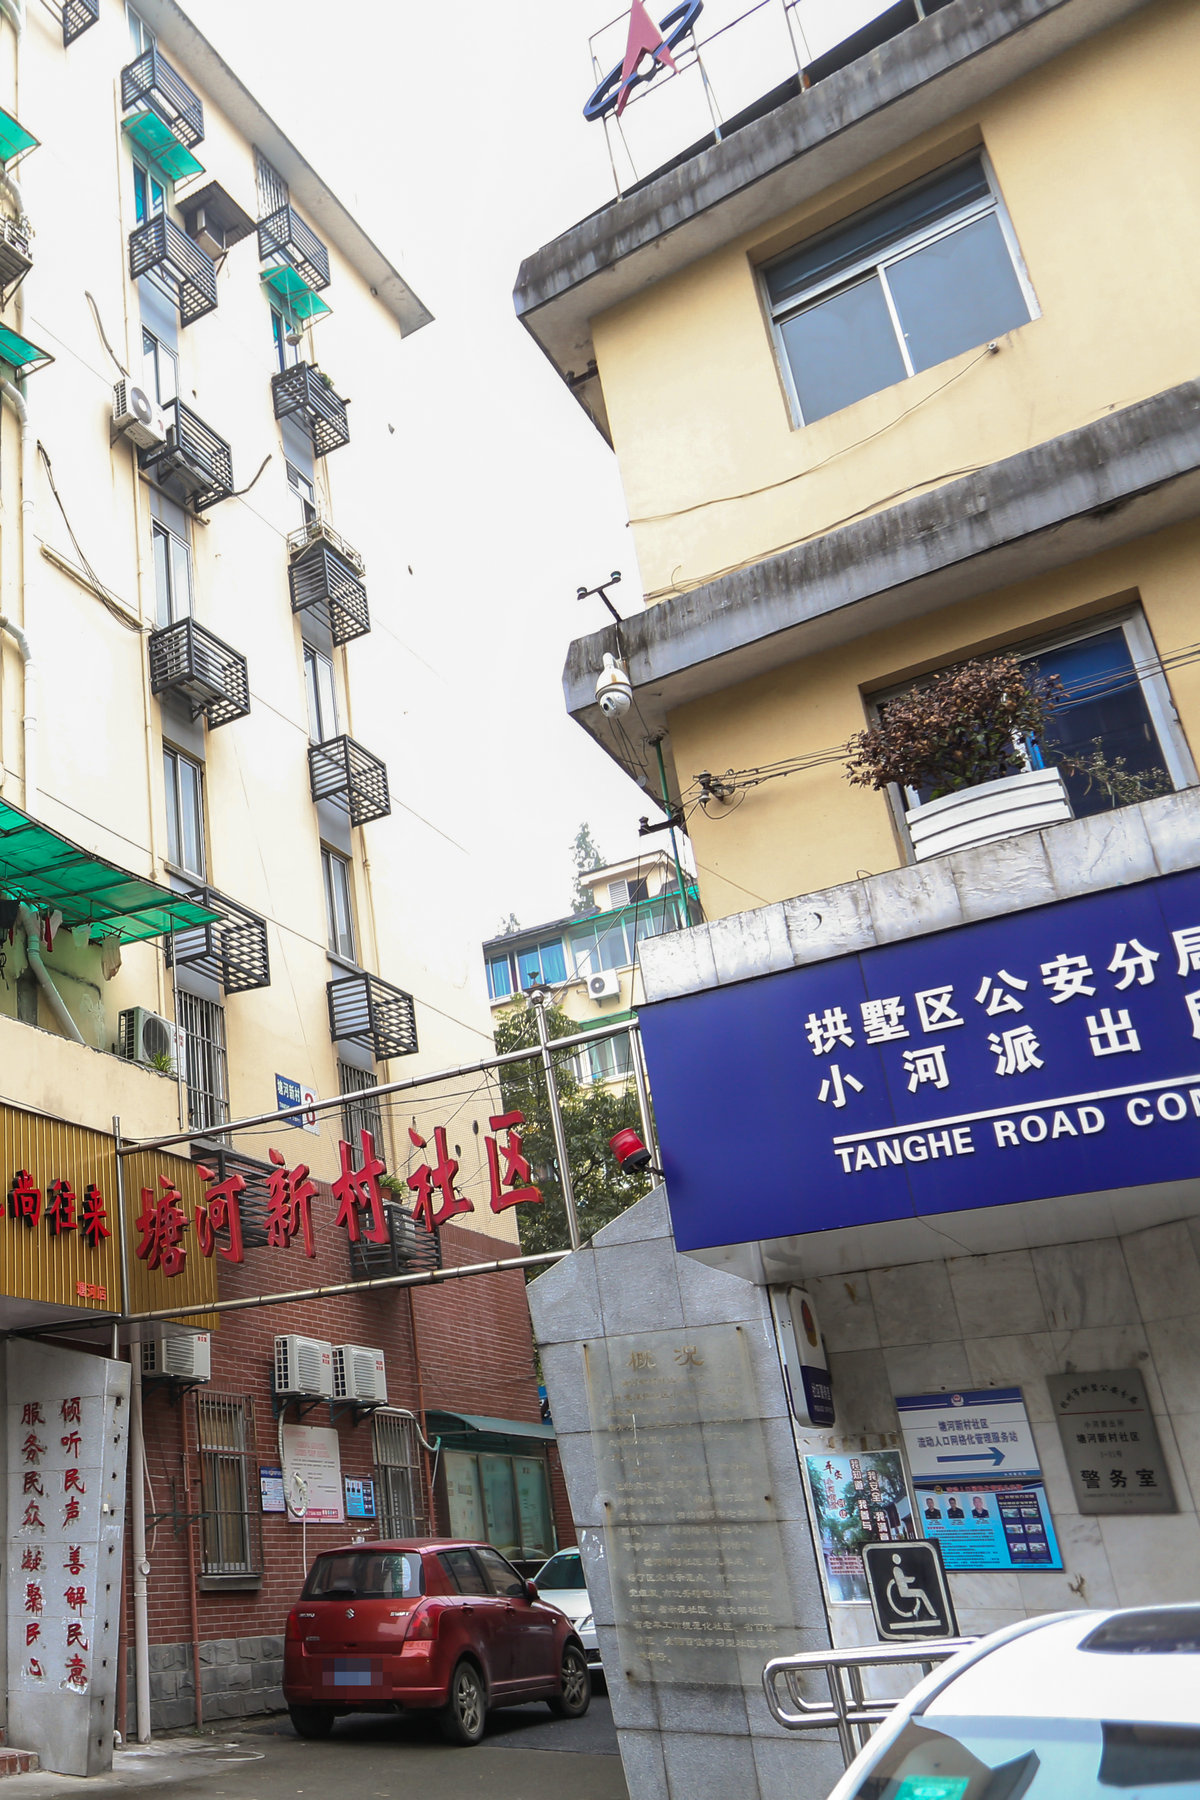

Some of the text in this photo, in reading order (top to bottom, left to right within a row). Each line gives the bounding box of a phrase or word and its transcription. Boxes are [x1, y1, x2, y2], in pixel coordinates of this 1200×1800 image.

[818, 991, 1200, 1109] 小河派出
[834, 1127, 975, 1174] TANGHE
[994, 1106, 1106, 1148] ROAD
[135, 1110, 544, 1278] 塘河新村社区
[76, 1281, 107, 1301] 塘河店
[626, 1345, 705, 1370] 概况
[938, 1418, 990, 1432] 塘河新村社区
[917, 1431, 1018, 1448] 流动人口网格化管理服务站
[1076, 1431, 1141, 1444] 塘河新村社区
[1080, 1468, 1158, 1489] 警务室
